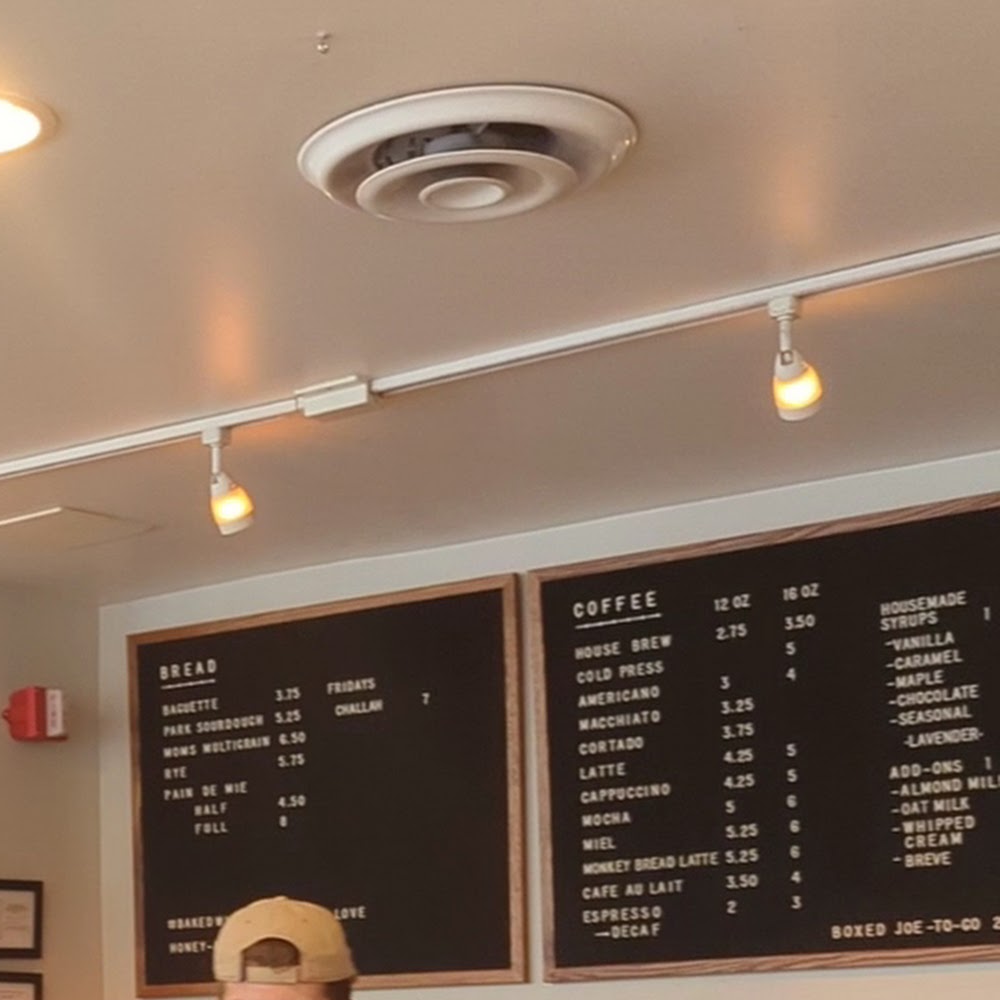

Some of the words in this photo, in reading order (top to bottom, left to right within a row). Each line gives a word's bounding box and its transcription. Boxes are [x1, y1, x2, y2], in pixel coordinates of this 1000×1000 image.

[573, 590, 658, 618] COFFEE
[714, 598, 729, 611] 12
[733, 594, 750, 608] OZ
[783, 587, 798, 600] 16
[801, 583, 819, 597] OZ
[880, 591, 966, 616] HOUSEMADE
[881, 611, 938, 631] SYRUPS
[984, 607, 990, 620] 1
[575, 642, 620, 659] HOUSE
[632, 635, 671, 652] BREW
[716, 624, 747, 640] 2.75
[785, 614, 815, 630] 3.50
[160, 659, 216, 680] BREAD
[577, 668, 612, 683] COLD
[619, 661, 664, 677] PRESS
[786, 642, 795, 655] 5
[327, 678, 375, 694] FRIDAYS
[578, 686, 659, 707] AMERICANO
[721, 676, 730, 689] 3
[787, 668, 796, 680] 4
[163, 698, 217, 716] BAGUETTE
[276, 687, 300, 701] 3.75
[335, 700, 382, 716] CHALLAH
[422, 693, 429, 704] 7
[579, 710, 660, 730] MACCHIATO
[722, 698, 754, 714] 3.25
[164, 724, 191, 736] PARK
[196, 715, 263, 733] SOURDOUGH
[275, 710, 301, 723] 5.25
[164, 745, 196, 757] MOMS
[203, 736, 270, 753] MULTIGRAIN
[279, 732, 306, 745] 6.50
[579, 737, 643, 755] CORTADO
[723, 723, 754, 739] 3.75
[164, 766, 186, 779] RYE
[278, 754, 305, 767] 5.75
[580, 762, 625, 779] LATTE
[724, 749, 753, 762] 4.25
[787, 744, 796, 756] 5
[890, 760, 963, 779] ADD-ONS
[985, 757, 991, 770] 1
[164, 788, 193, 800] PAIN
[202, 785, 216, 796] DE
[225, 782, 246, 793] MIE
[581, 783, 670, 803] CAPPUCCINO
[724, 774, 754, 788] 4.25
[787, 769, 797, 782] 5
[195, 802, 226, 815] HALF
[278, 795, 305, 807] 4.50
[582, 812, 630, 826] MOCHA
[726, 800, 735, 813] 5
[787, 795, 797, 807] 6
[933, 797, 969, 811] MILK
[195, 822, 227, 834] FULL
[583, 837, 615, 850] MIEL
[726, 824, 758, 838] 5.25
[790, 820, 800, 832] 6
[905, 832, 962, 848] CREAM
[583, 860, 630, 874] MONKEY
[635, 856, 676, 871] BREAD
[679, 852, 718, 867] LATTE
[725, 849, 758, 863] 5.25
[790, 846, 800, 858] 6
[582, 885, 618, 899] CAFE
[625, 884, 643, 895] AU
[649, 880, 683, 894] LAIT
[727, 874, 758, 888] 3.50
[791, 871, 801, 882] 4
[335, 906, 366, 920] LOVE
[583, 906, 661, 923] ESPRESSO
[727, 901, 736, 913] 2
[792, 896, 801, 909] 3
[832, 923, 886, 939] BOXED
